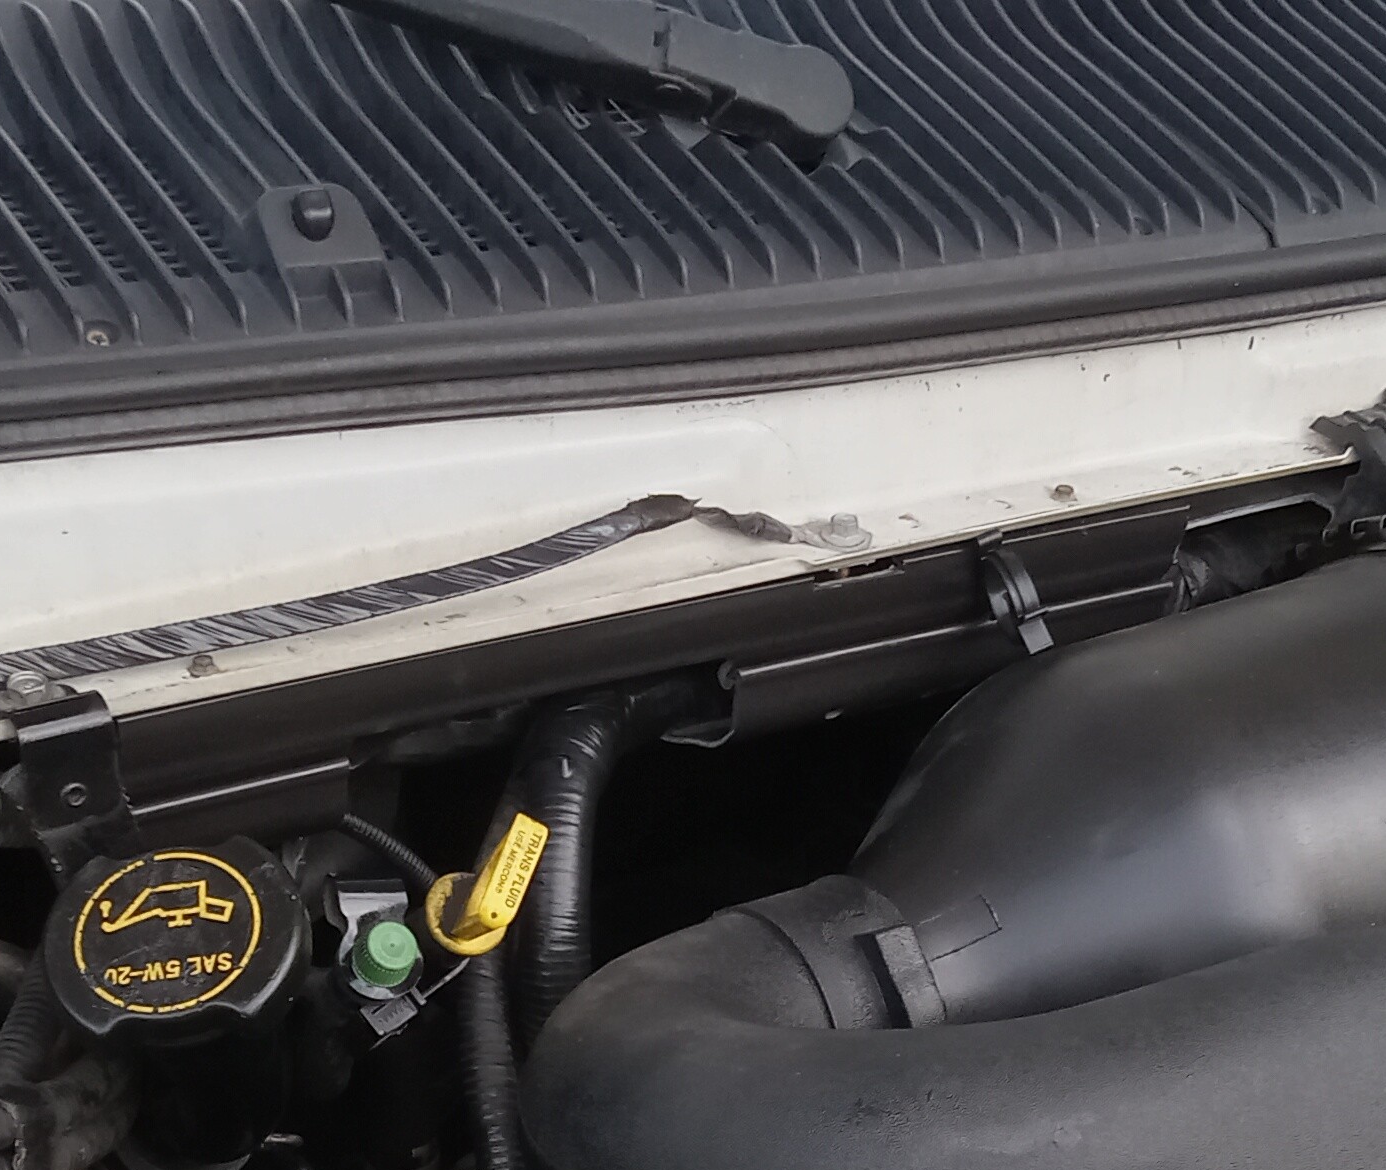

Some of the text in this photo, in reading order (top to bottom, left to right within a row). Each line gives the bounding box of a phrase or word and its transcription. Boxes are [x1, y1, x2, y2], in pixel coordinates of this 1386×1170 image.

[513, 830, 526, 849] USE
[505, 831, 543, 909] TRANS FLUID
[187, 952, 234, 976] SAE
